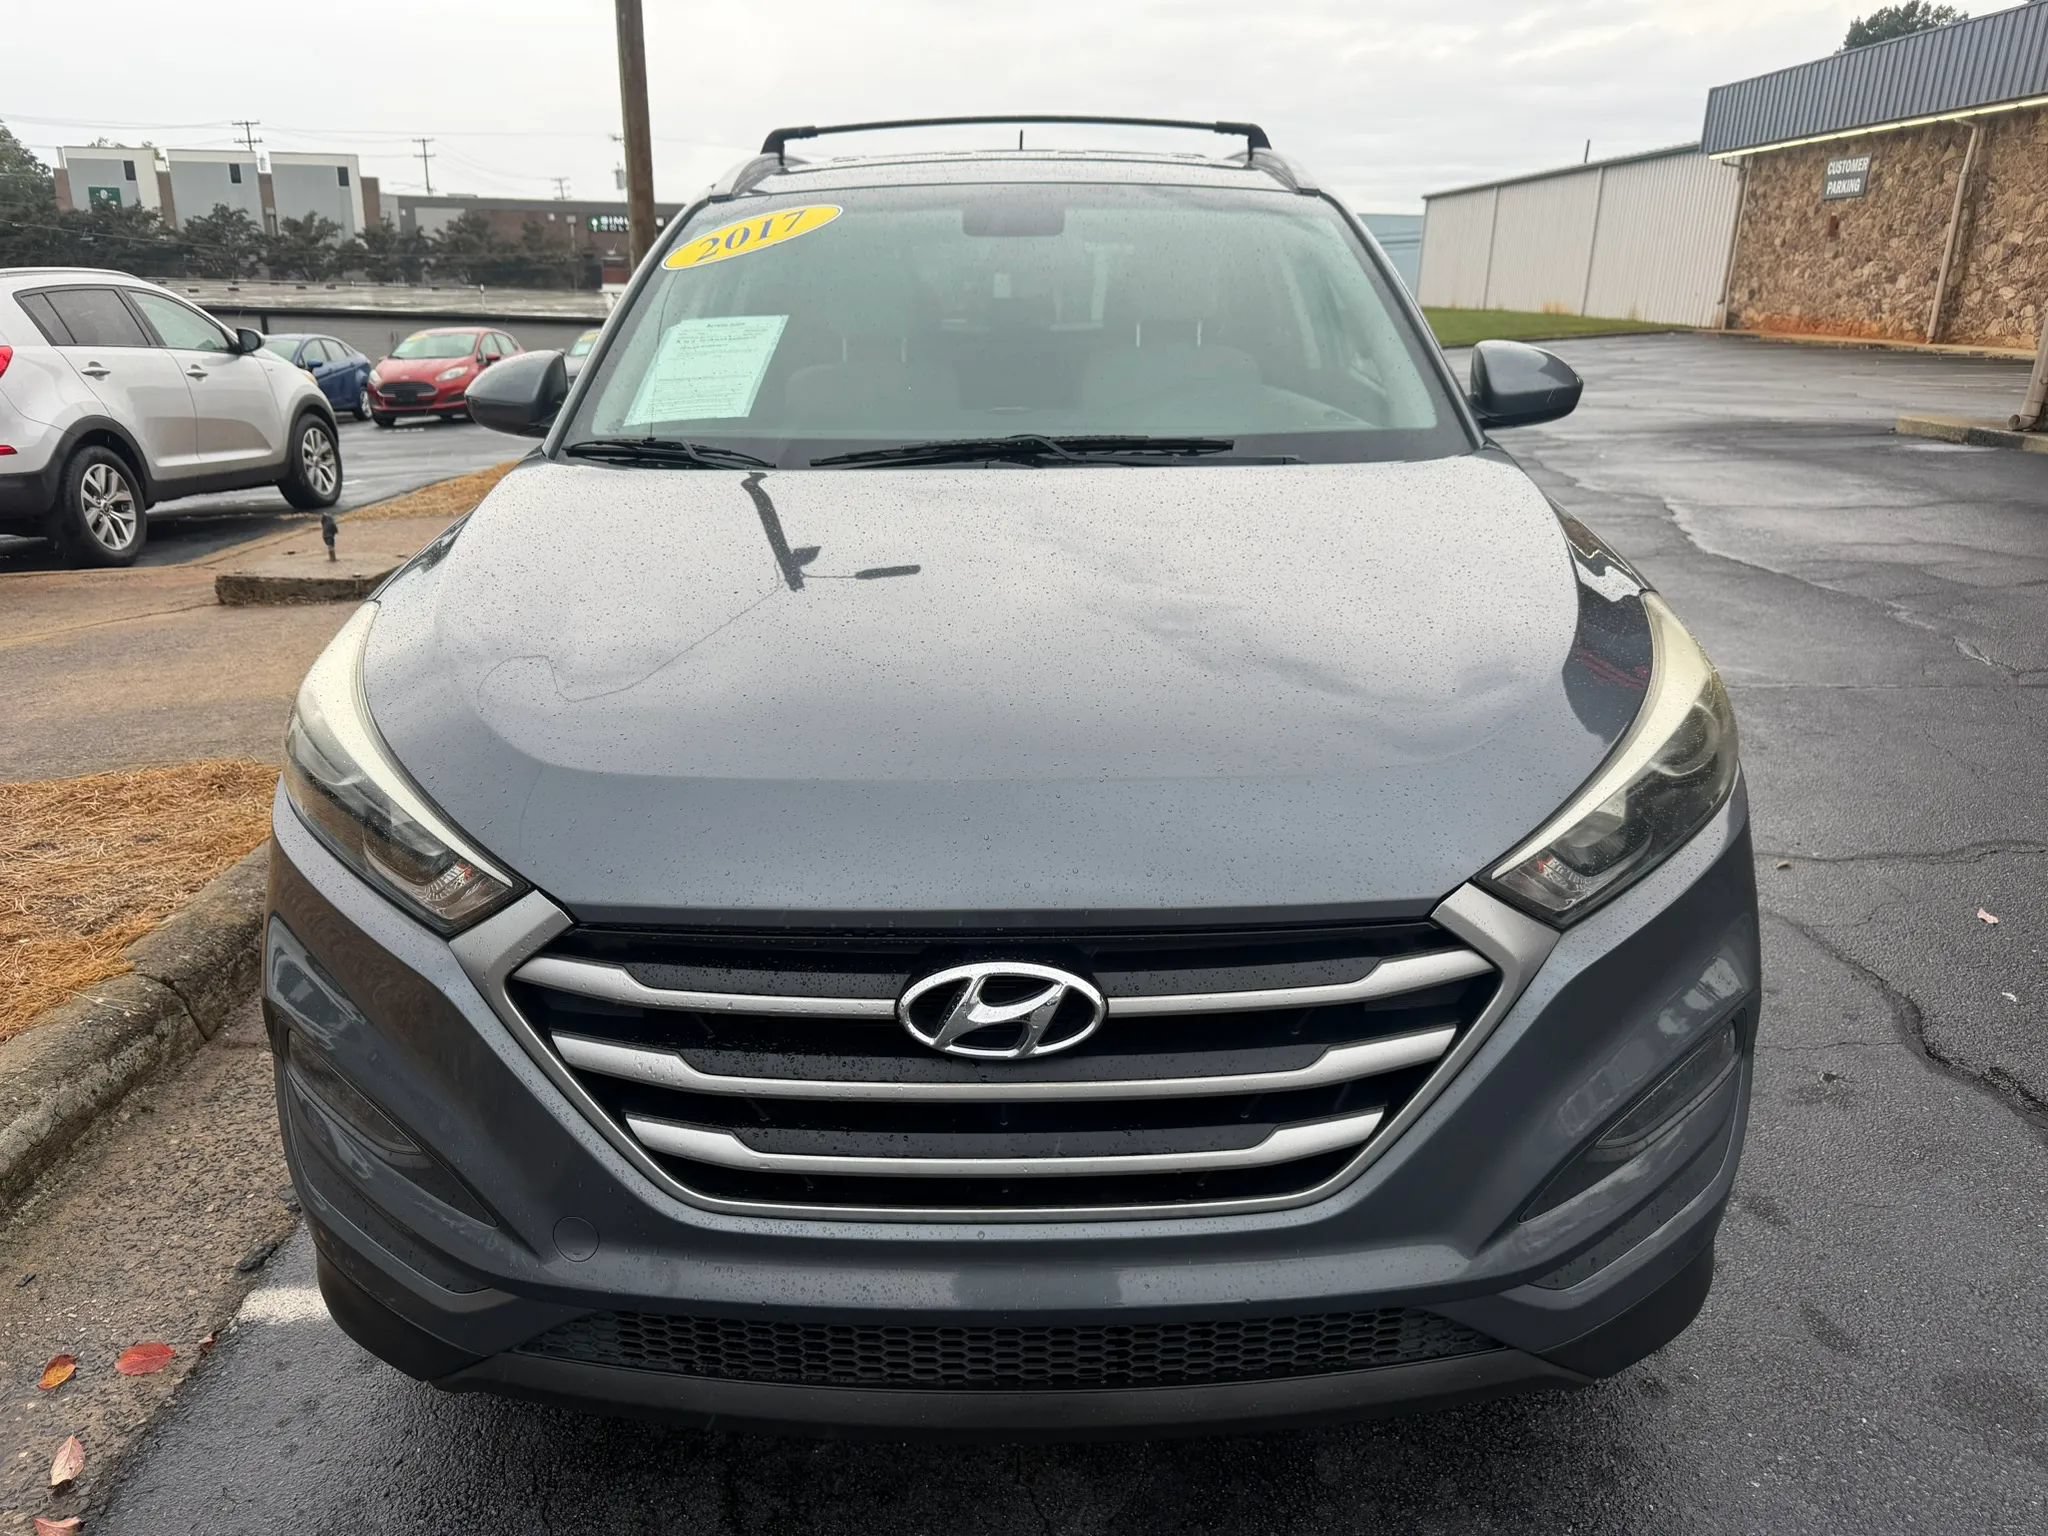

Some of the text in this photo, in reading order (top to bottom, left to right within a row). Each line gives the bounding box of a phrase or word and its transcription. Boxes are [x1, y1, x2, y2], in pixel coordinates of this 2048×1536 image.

[1827, 157, 1870, 175] CUSTOMER
[1826, 178, 1861, 195] PARKING
[695, 209, 807, 262] 2017
